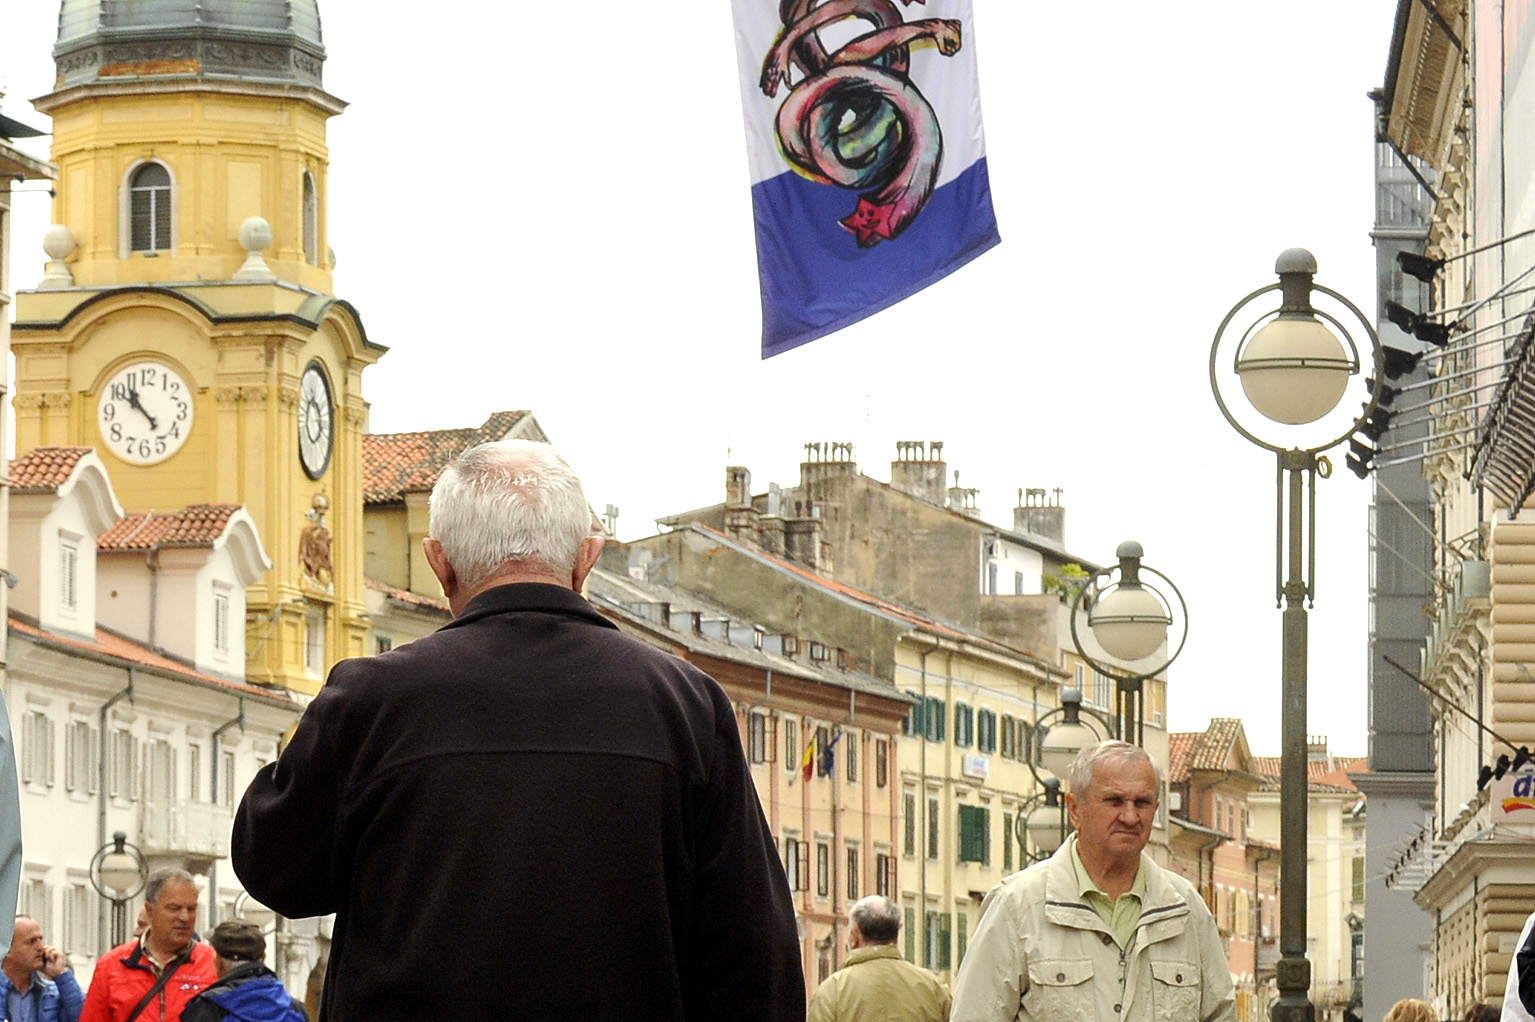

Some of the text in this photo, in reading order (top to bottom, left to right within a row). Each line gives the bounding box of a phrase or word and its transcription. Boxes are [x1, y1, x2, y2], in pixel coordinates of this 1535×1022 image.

[141, 368, 156, 387] 12
[170, 382, 180, 401] 2
[104, 402, 115, 422] 9
[176, 401, 188, 421] 3
[110, 422, 122, 443] 8
[168, 420, 180, 439] 4
[126, 436, 136, 454] 7
[139, 439, 151, 458] 6
[155, 435, 167, 454] 5
